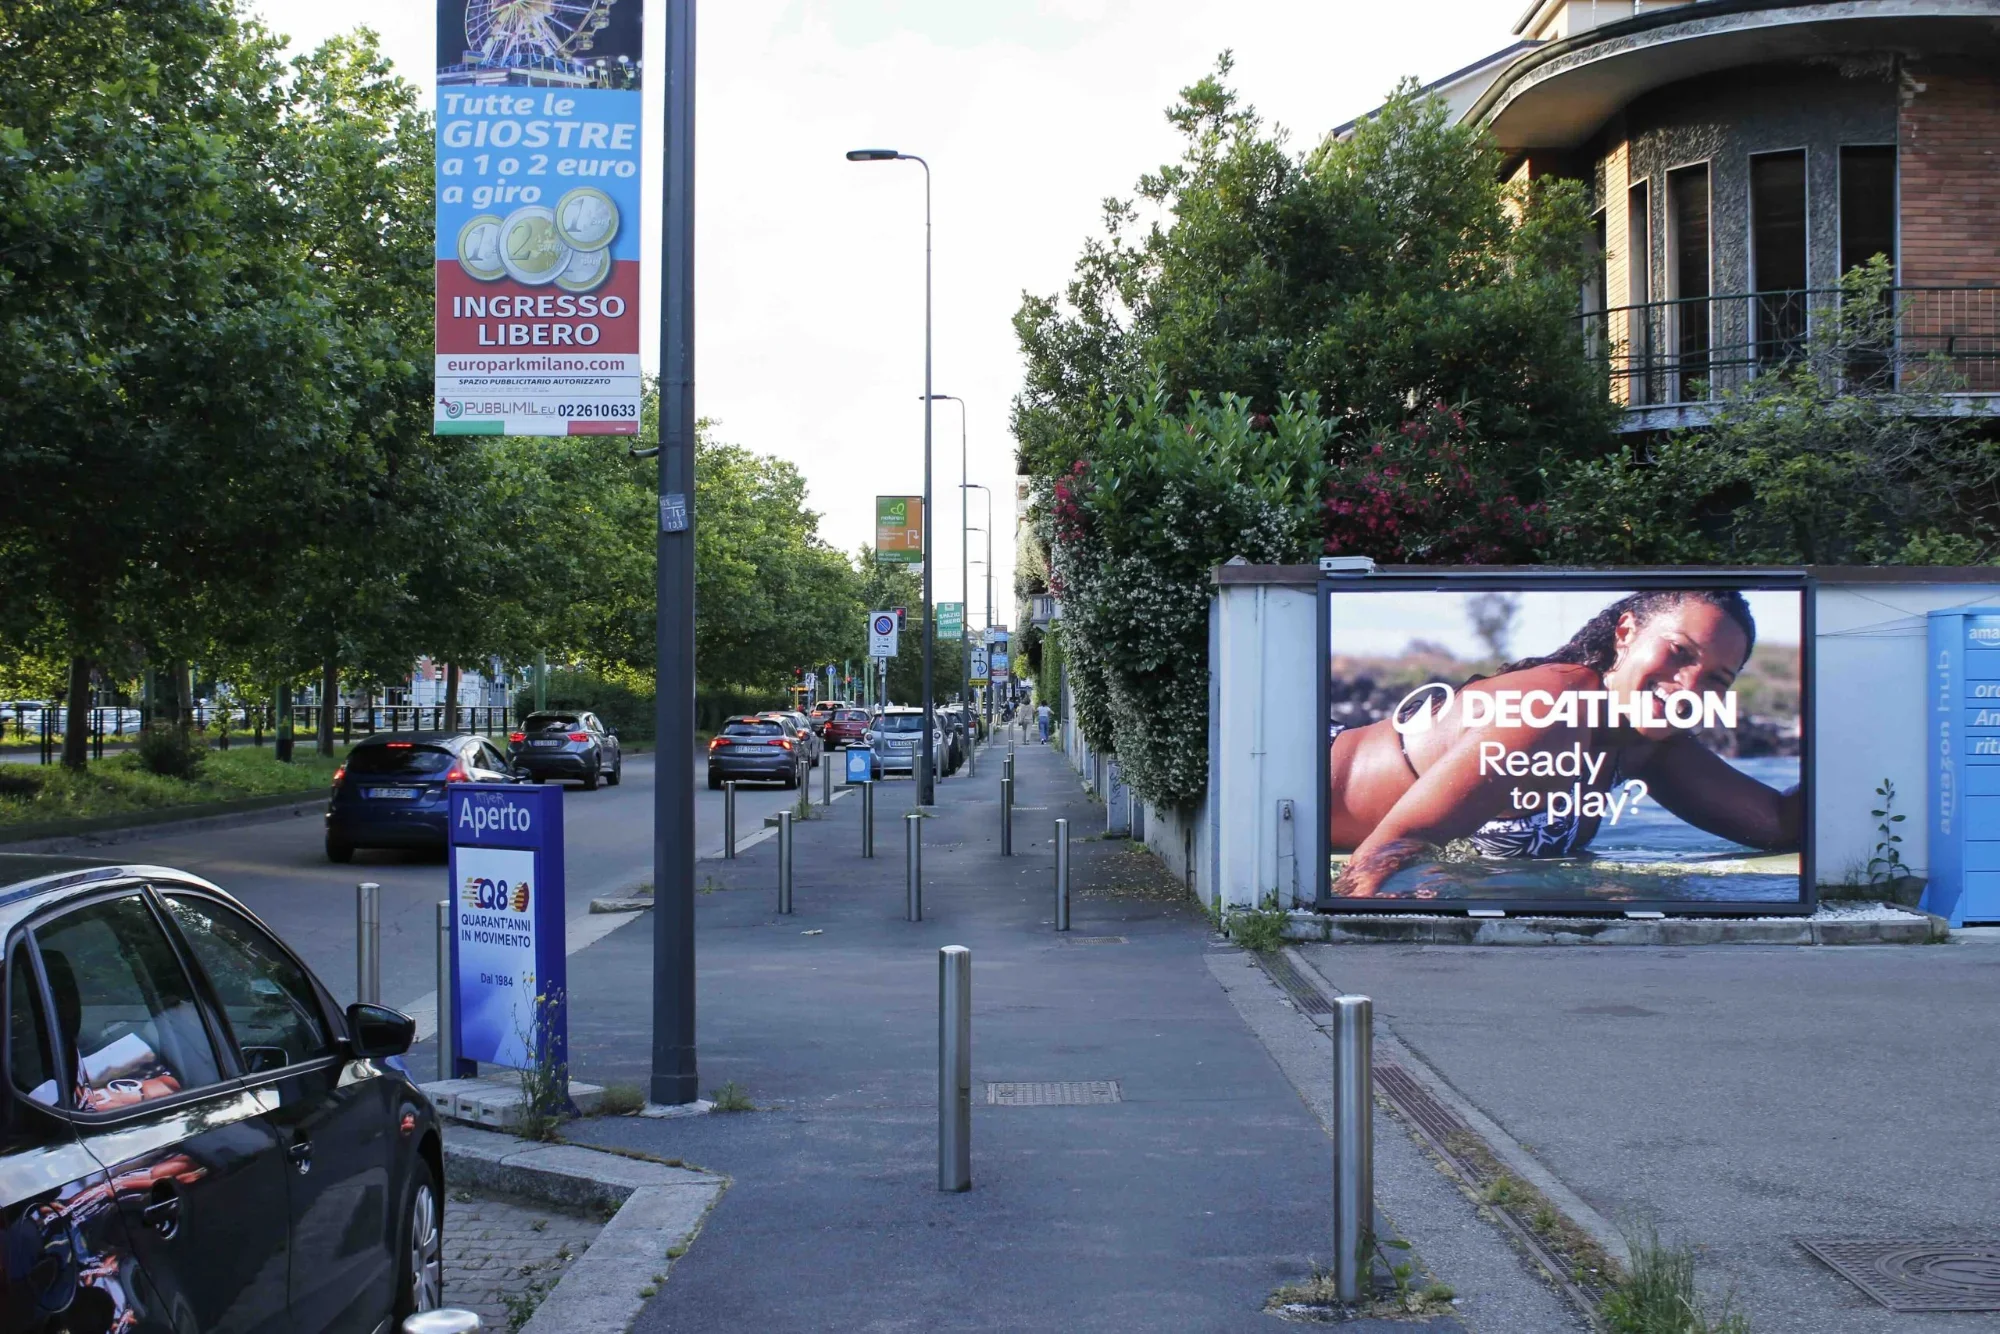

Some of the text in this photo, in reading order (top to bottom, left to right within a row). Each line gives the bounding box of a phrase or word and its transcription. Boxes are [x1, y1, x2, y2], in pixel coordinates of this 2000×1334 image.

[443, 93, 575, 116] Tutte le
[443, 120, 637, 150] GIOSTRE
[442, 154, 636, 178] a 1 o 2 euro
[442, 178, 542, 209] a giro
[453, 295, 626, 318] INGRESSO
[478, 323, 600, 346] LIBERO
[447, 356, 625, 374] europarkmilano.com
[1462, 690, 1737, 728] DECATHLON
[1936, 650, 1951, 836] amazon hub
[1480, 741, 1606, 785] Ready
[1510, 779, 1648, 825] to play?
[459, 797, 531, 838] Aperto
[479, 878, 508, 911] Q8
[461, 929, 531, 948] IN MOVIMENTO
[480, 972, 513, 987] Dal 1984
